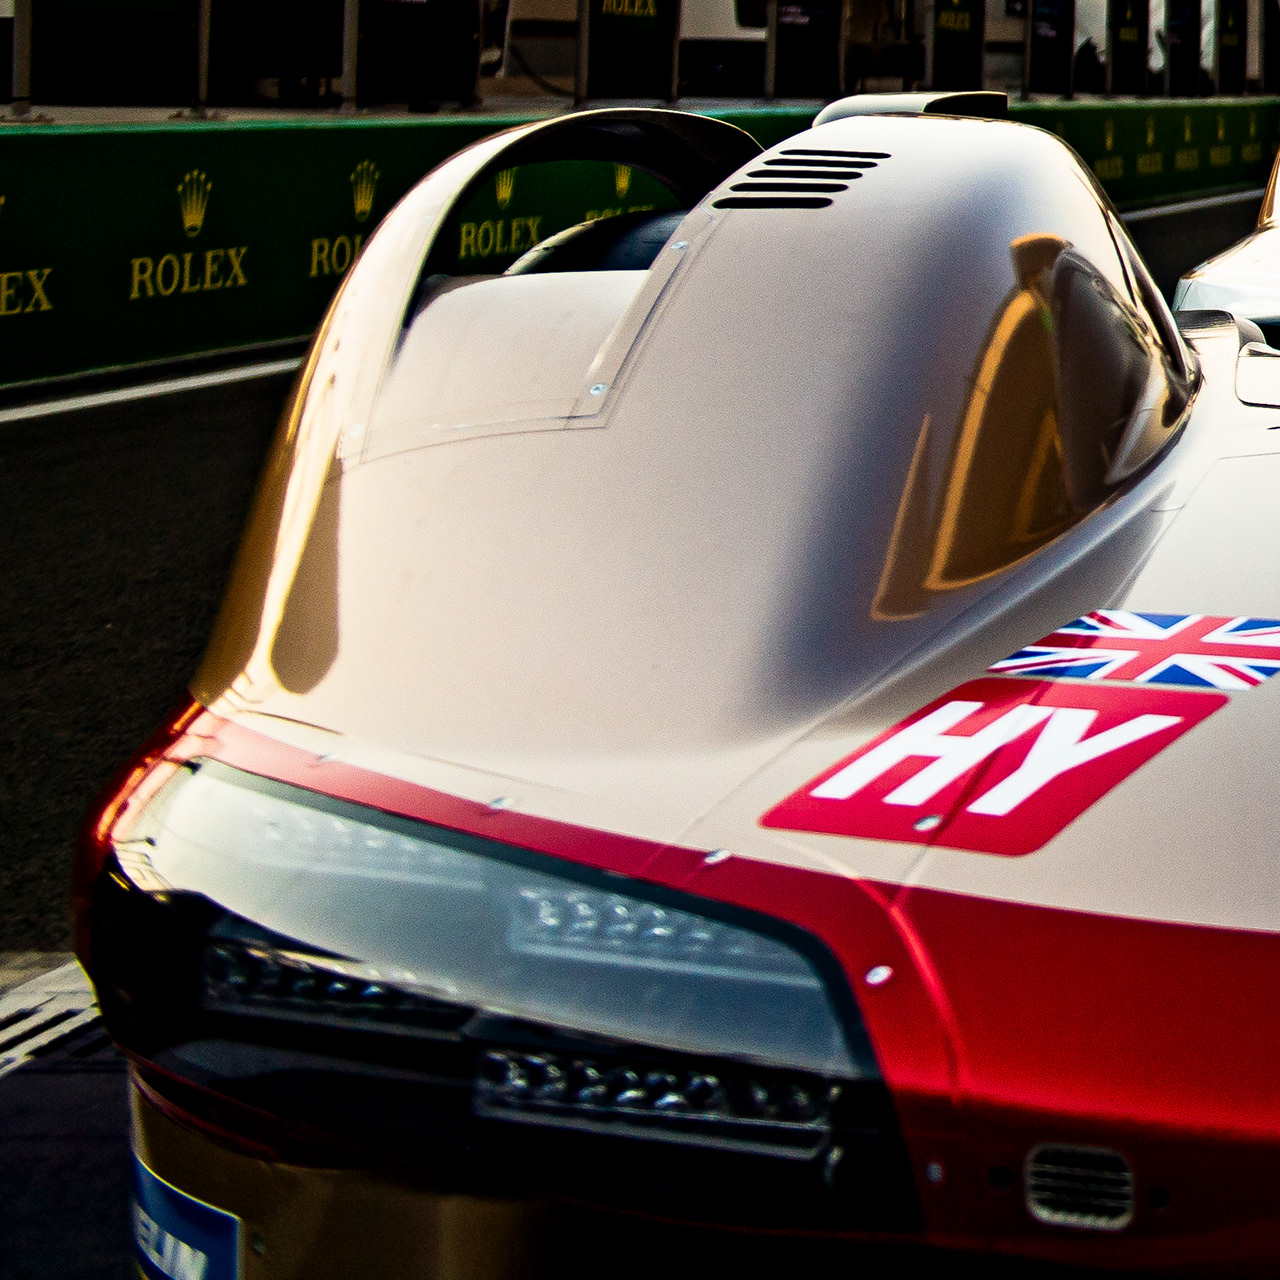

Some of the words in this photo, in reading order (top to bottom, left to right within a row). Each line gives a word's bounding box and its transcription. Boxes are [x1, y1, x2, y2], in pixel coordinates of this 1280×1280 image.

[458, 215, 544, 260] ROLEX
[128, 245, 249, 302] ROLEX
[809, 699, 1183, 817] HY
